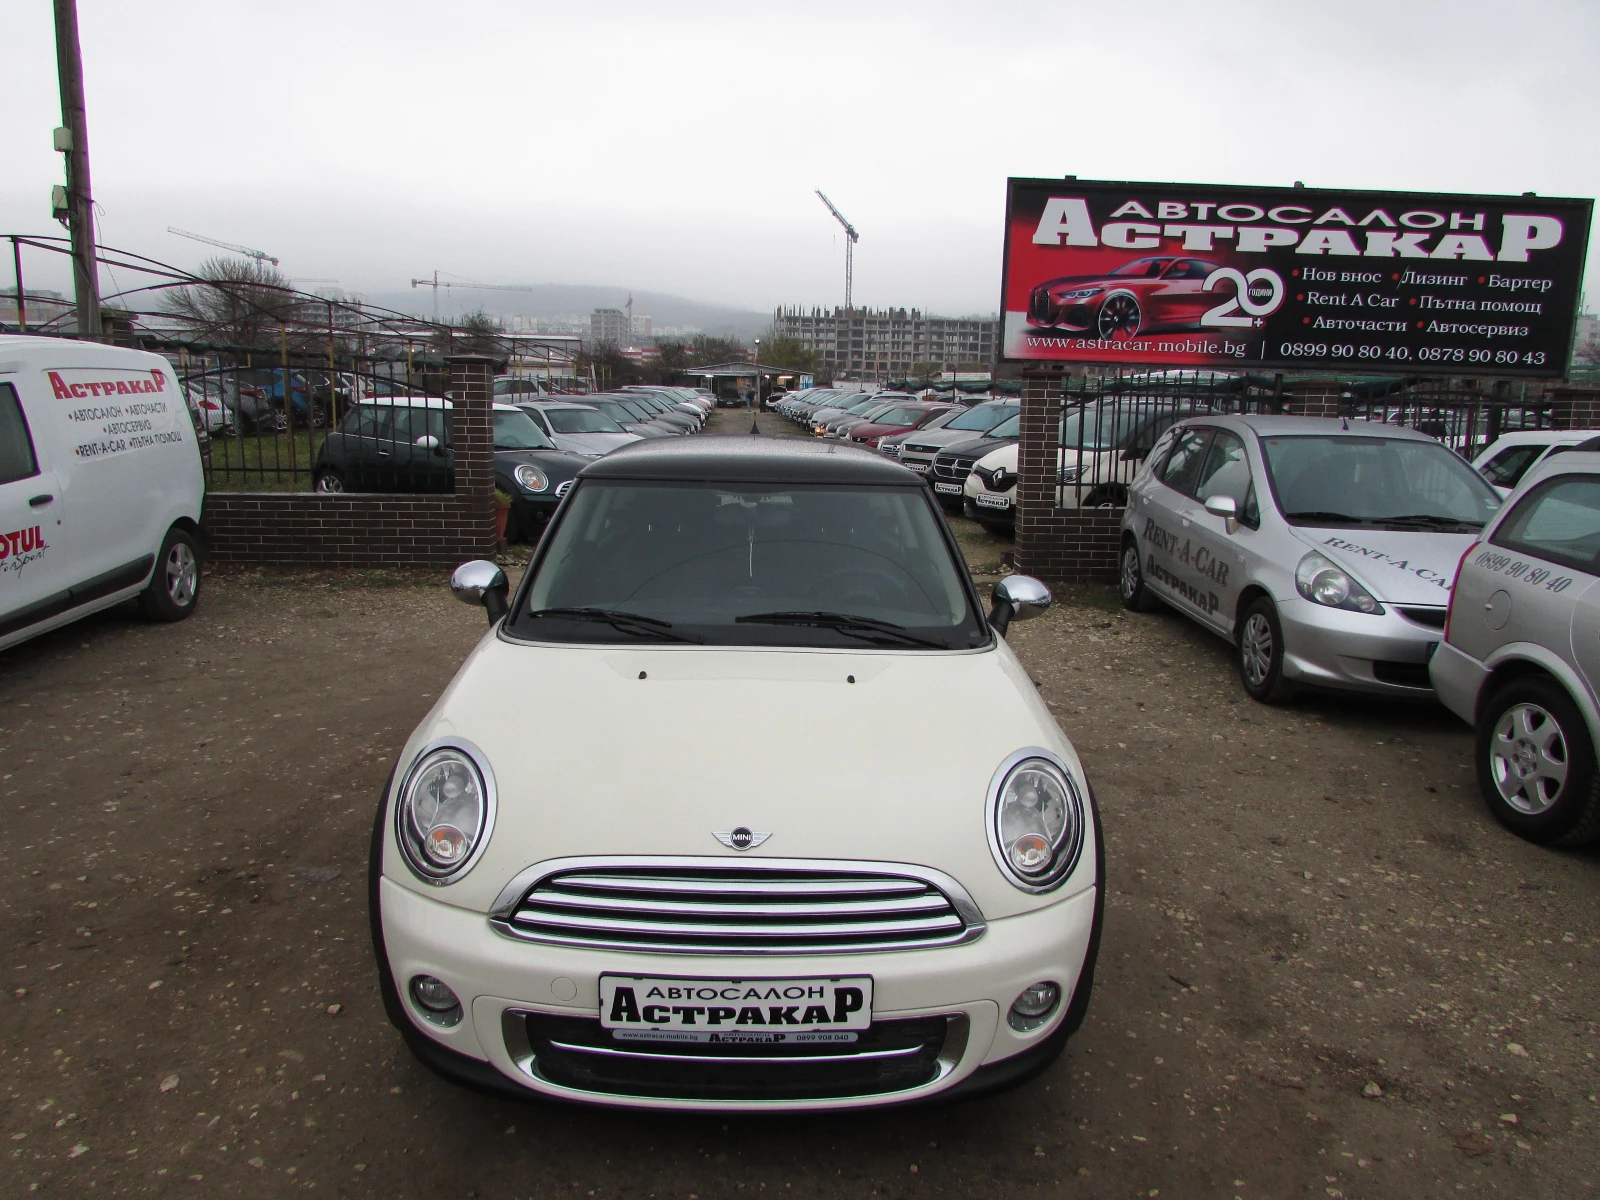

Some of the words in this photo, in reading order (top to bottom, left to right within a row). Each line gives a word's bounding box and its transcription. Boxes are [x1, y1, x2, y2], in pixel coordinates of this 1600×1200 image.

[1109, 201, 1485, 231] АВТОСАЛОН
[1032, 198, 1563, 262] АСТРАКАР
[1302, 267, 1336, 281] Нов
[1340, 272, 1382, 283] внос
[1401, 271, 1468, 286] Лизинг
[1488, 274, 1552, 292] Бартер
[1249, 288, 1273, 297] ГОДИНИ
[1306, 291, 1347, 306] Rent
[1350, 293, 1363, 306] A
[1367, 294, 1399, 308] Car
[1419, 295, 1476, 311] Пътна
[1479, 301, 1542, 315] помощ
[1312, 316, 1408, 332] Авточасти
[1426, 320, 1529, 338] Автосервиз
[1026, 336, 1246, 357] www.astracar.mobile.bg
[1280, 342, 1327, 357] 0899
[1331, 344, 1354, 358] 90
[1358, 345, 1381, 359] 80
[1385, 346, 1412, 361] 40,
[1418, 347, 1464, 362] 0878
[1468, 349, 1491, 363] 90
[1495, 350, 1518, 364] 80
[1522, 352, 1546, 365] 43
[48, 369, 165, 399] АСТРАКАР
[73, 406, 124, 422] АВТОСАЛОН
[129, 402, 168, 416] АВТОЧАСТИ
[107, 419, 152, 435] АВТОСЕРВИЗ
[79, 439, 127, 457] RENT-A-CAR
[131, 435, 155, 449] ПЪТНА
[154, 431, 182, 445] ПОМОЩ
[1142, 517, 1229, 588] RENT-A-CAR
[1474, 551, 1511, 571] 0899
[1504, 561, 1530, 578] 90
[1523, 567, 1550, 585] 80
[1545, 576, 1572, 593] 40
[1146, 553, 1219, 616] АСТРАКАР
[646, 986, 824, 1000] АВТОСАЛОН
[610, 986, 863, 1025] АСТРАКАР
[622, 1031, 698, 1041] www.astracar.mobile.bg
